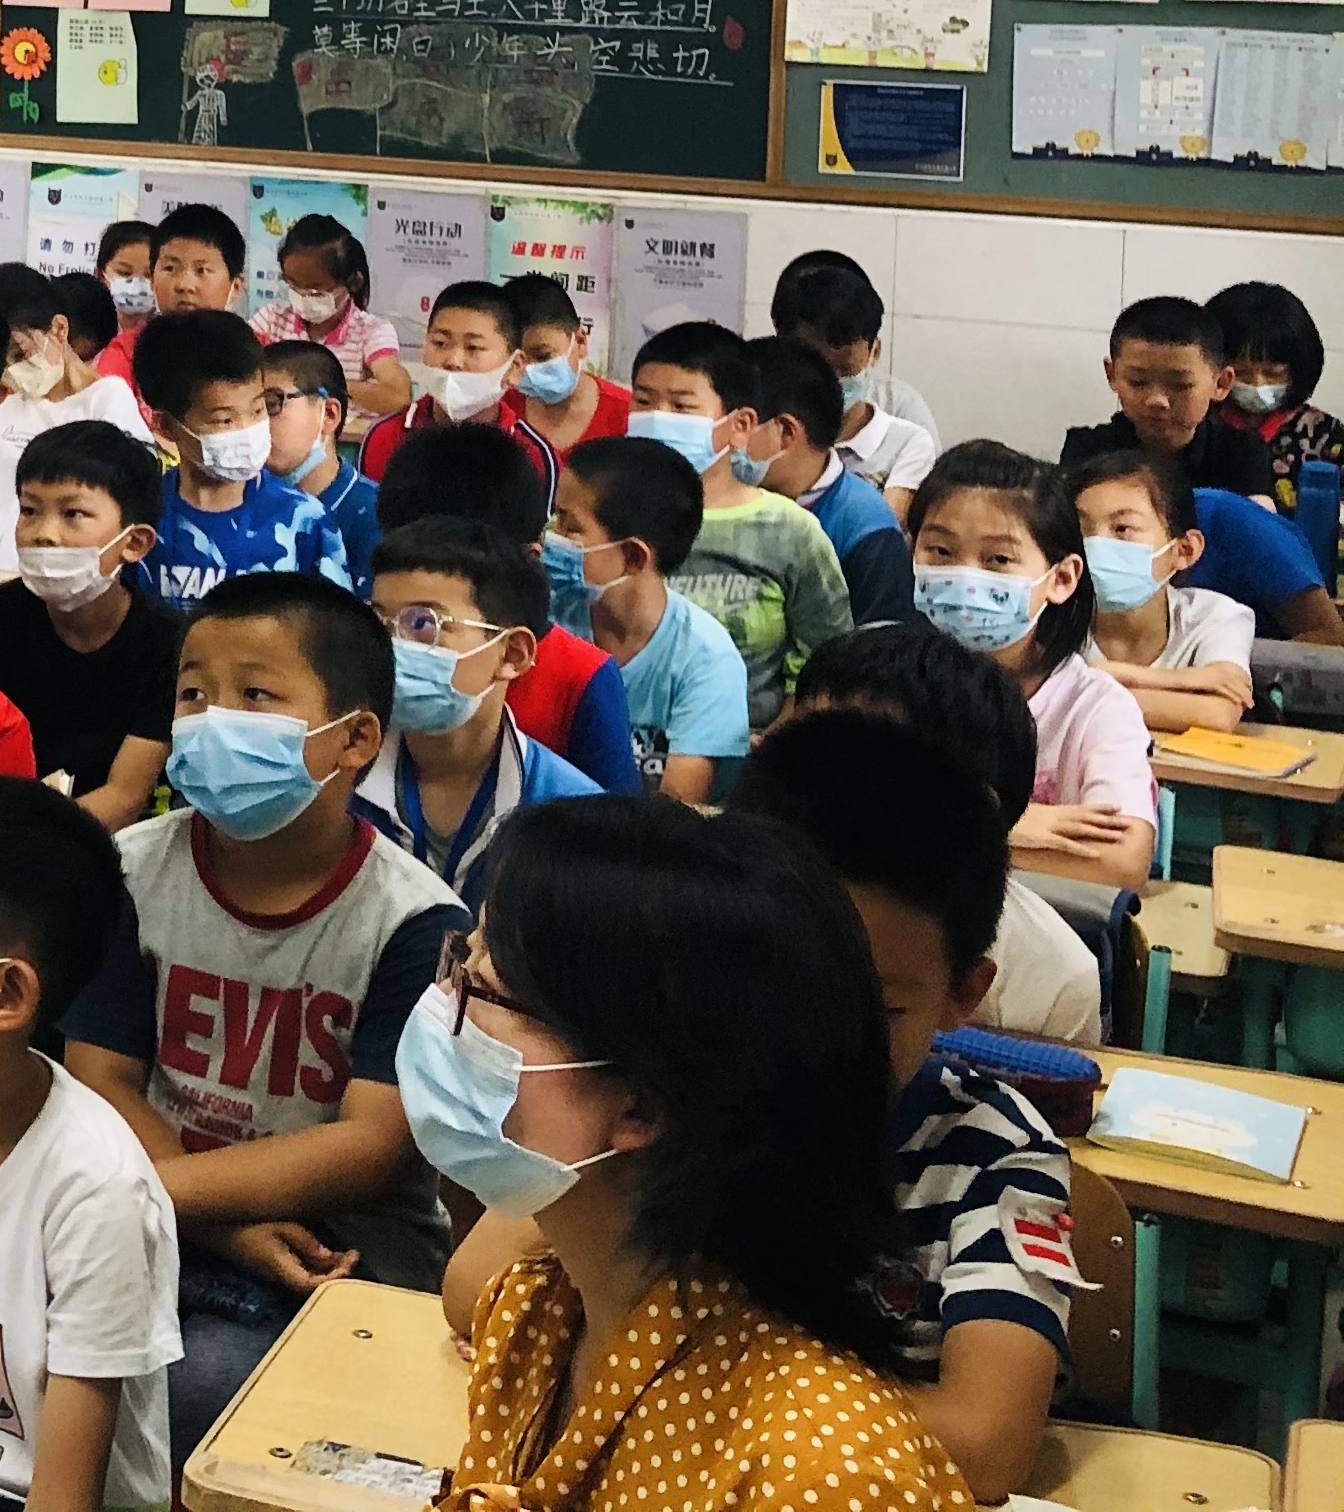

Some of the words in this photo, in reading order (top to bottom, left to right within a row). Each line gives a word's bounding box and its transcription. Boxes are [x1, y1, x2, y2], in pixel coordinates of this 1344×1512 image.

[395, 218, 463, 239] 光盘行动
[159, 963, 353, 1105] EVI'S
